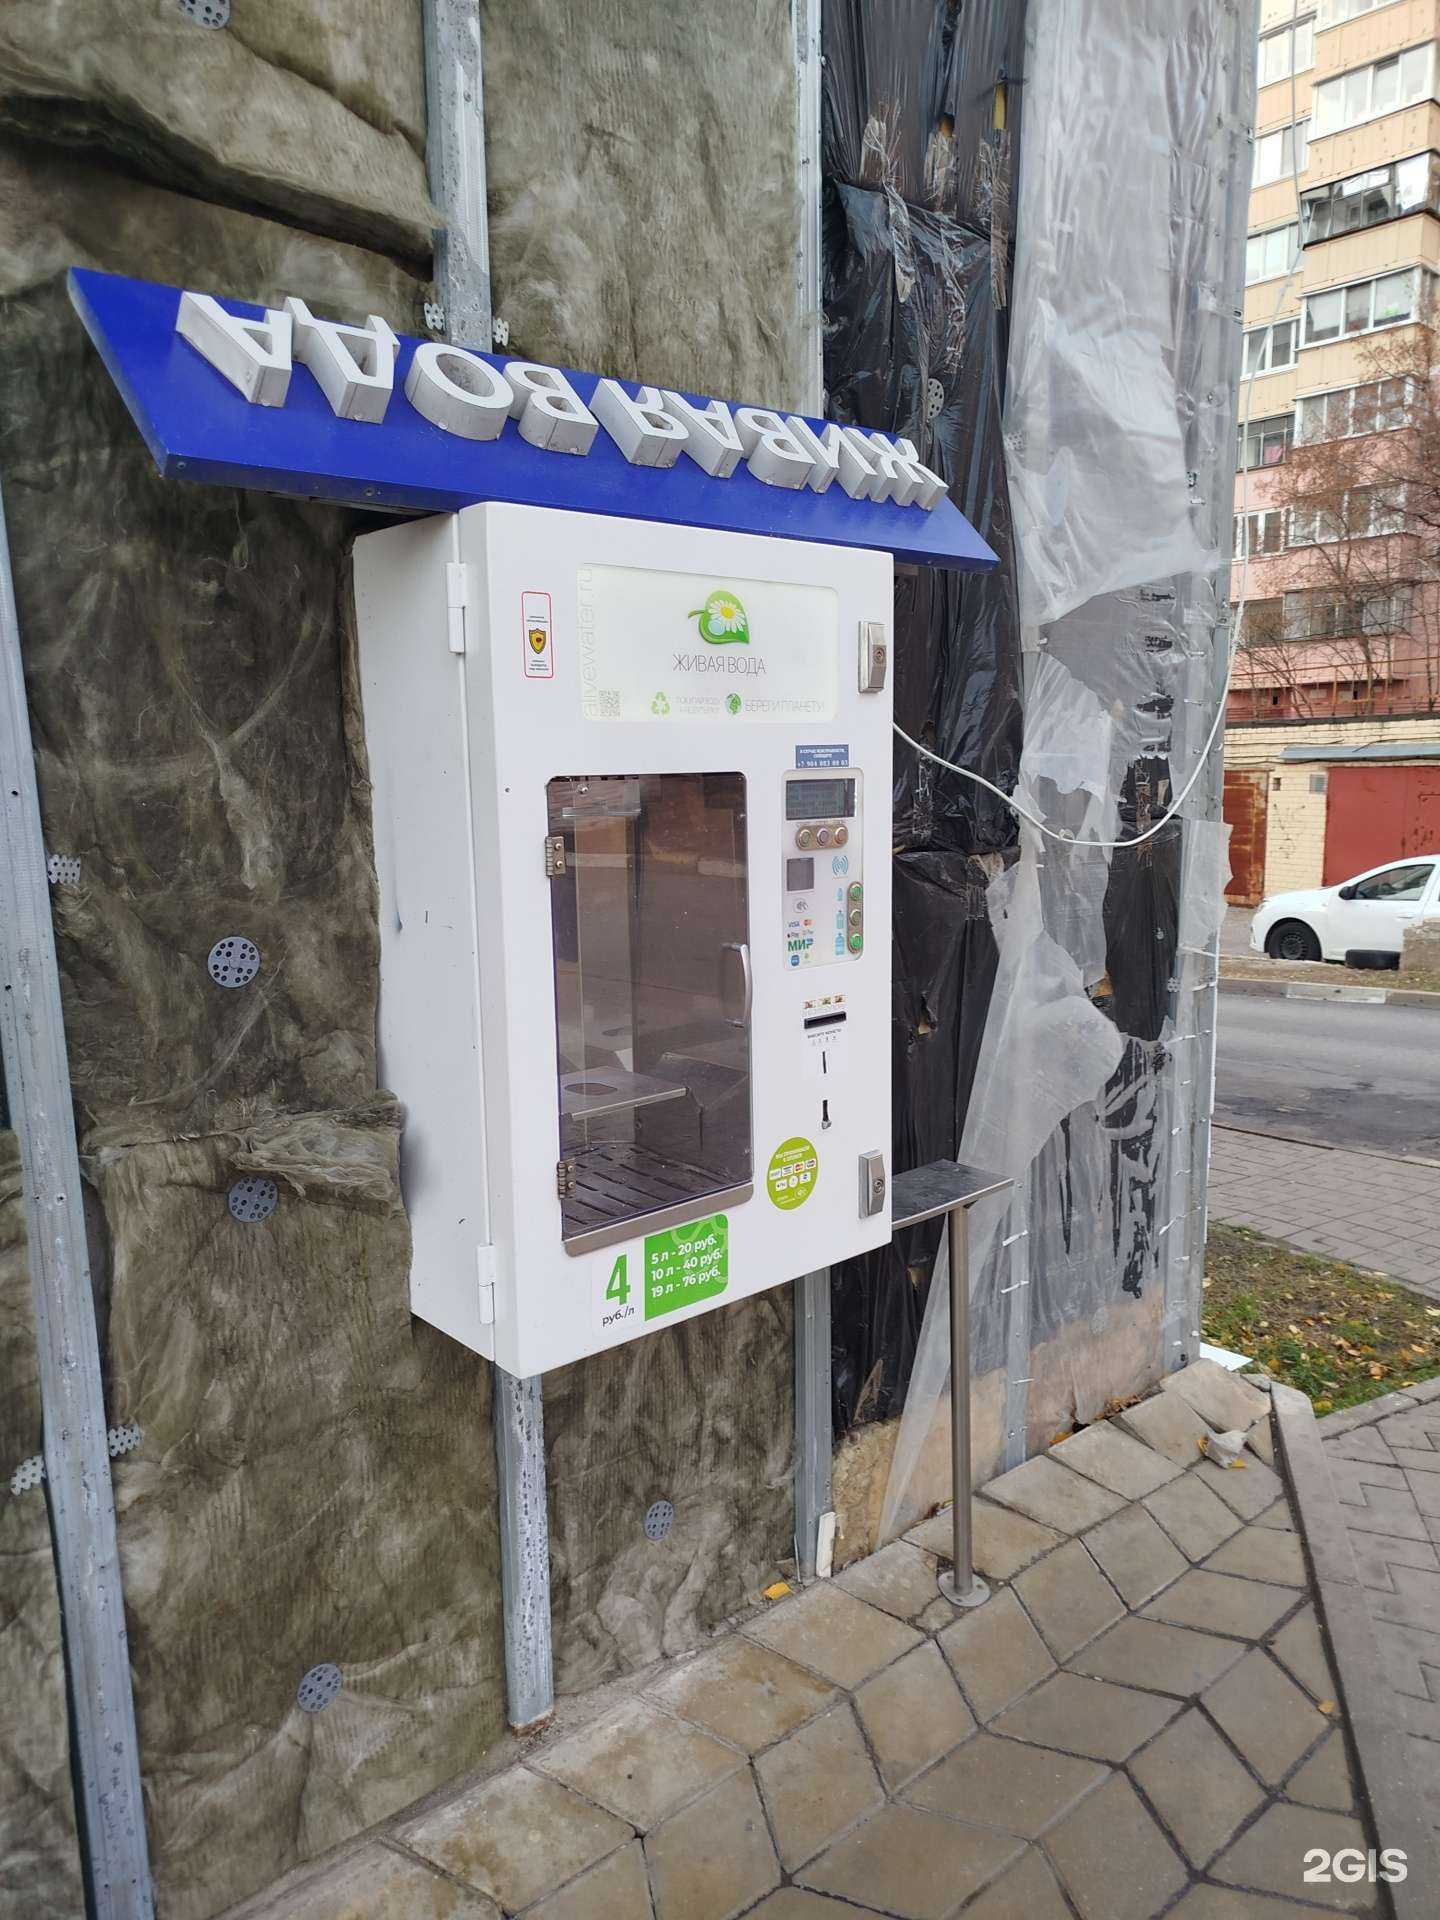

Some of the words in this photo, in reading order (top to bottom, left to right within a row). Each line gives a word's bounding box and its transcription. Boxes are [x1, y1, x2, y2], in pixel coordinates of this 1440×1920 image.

[176, 291, 598, 456] ВОДА
[589, 378, 948, 512] ЖИВАЯ
[672, 654, 725, 673] ЖИВАЯ
[727, 657, 767, 676] ВОДА
[787, 938, 814, 952] МИР
[651, 1253, 659, 1265] 5
[660, 1251, 669, 1262] л
[678, 1242, 692, 1255] 20
[694, 1233, 717, 1252] руб.
[651, 1267, 664, 1281] 10
[665, 1266, 674, 1277] л
[682, 1257, 698, 1270] 40
[700, 1248, 723, 1267] руб.
[606, 1253, 631, 1306] 4
[651, 1285, 664, 1298] 19
[664, 1284, 674, 1295] л
[682, 1274, 697, 1287] 76
[698, 1265, 721, 1283] руб.
[602, 1305, 635, 1328] руб./л
